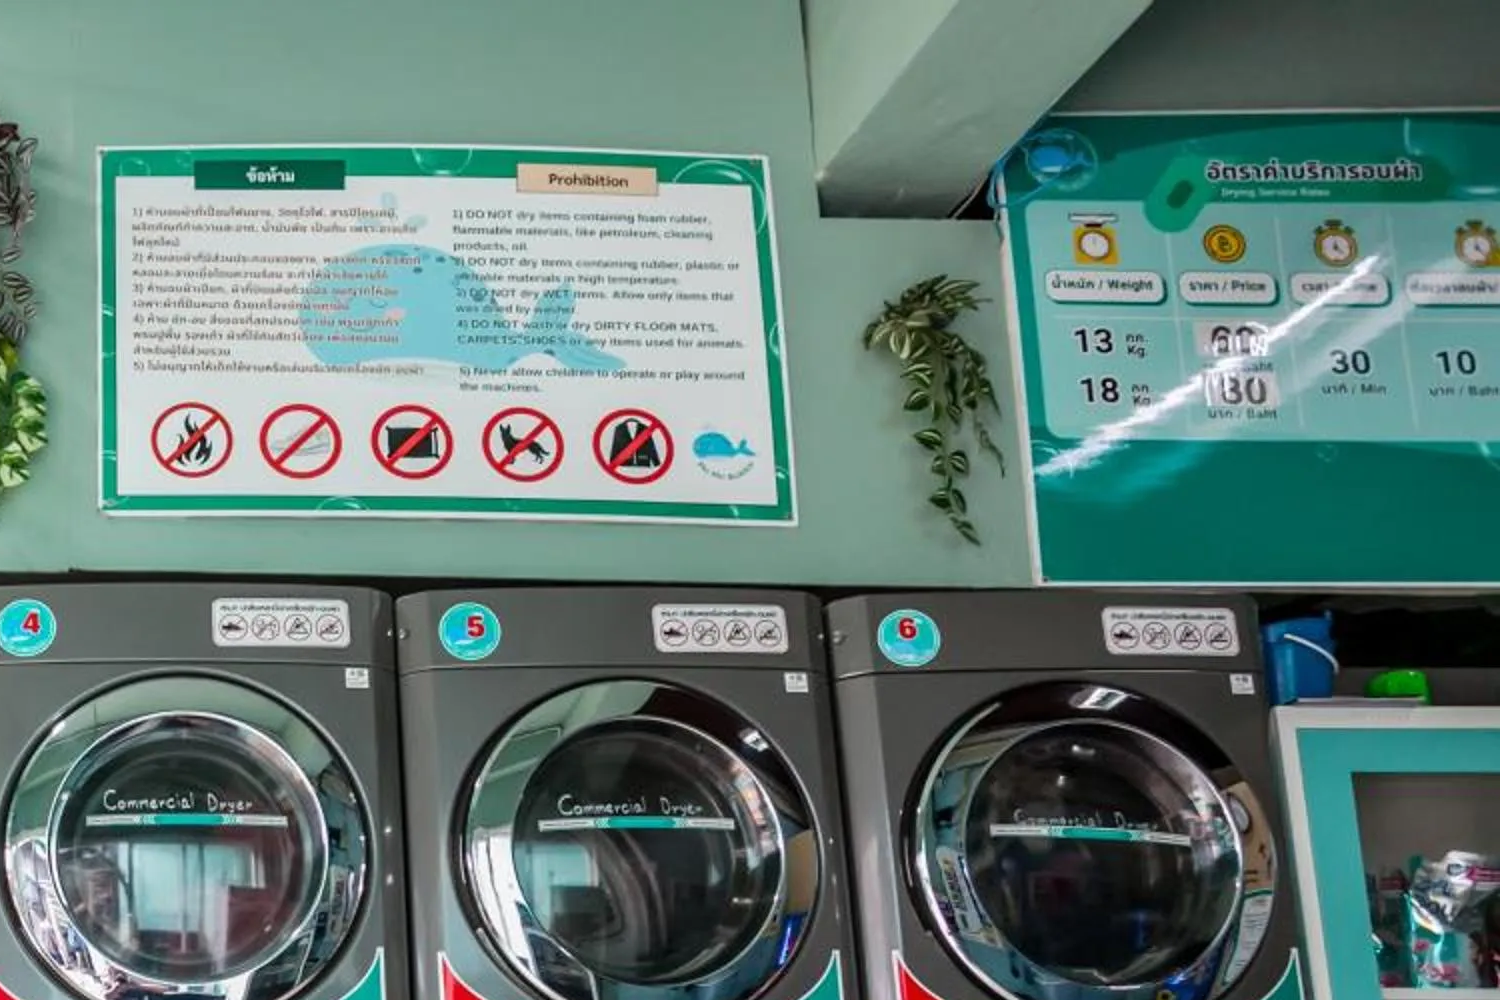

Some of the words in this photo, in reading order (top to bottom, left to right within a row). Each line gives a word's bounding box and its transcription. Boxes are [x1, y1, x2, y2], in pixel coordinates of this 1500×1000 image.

[245, 166, 295, 184] ข้อห้าม
[1206, 158, 1423, 182] อัตราค่าบริการอบผ้า
[549, 173, 629, 188] Prohibition
[466, 210, 485, 220] DO
[487, 210, 513, 220] NOT
[515, 211, 535, 222] dry
[573, 212, 635, 224] containing
[489, 257, 515, 267] NOT
[518, 258, 538, 270] dry
[575, 259, 638, 271] containing
[1052, 276, 1095, 290] น้ำหนัก
[1108, 279, 1153, 292] Weight
[1231, 281, 1266, 292] Price
[571, 321, 591, 333] dry
[595, 321, 632, 331] DIRTY
[634, 321, 677, 332] FLOOR
[645, 337, 675, 348] used
[1074, 328, 1114, 354] 13
[1330, 350, 1371, 375] 30
[1435, 350, 1476, 375] 10
[545, 368, 595, 378] children
[675, 370, 701, 382] play
[703, 371, 746, 381] around
[1080, 377, 1120, 404] 18
[1361, 384, 1387, 395] Min
[21, 610, 41, 634] 4
[466, 615, 485, 637] 5
[898, 617, 918, 640] 6
[103, 788, 194, 811] Commercial
[206, 792, 254, 813] Dryer
[556, 792, 647, 816] Commercial
[659, 795, 704, 816] Dryer
